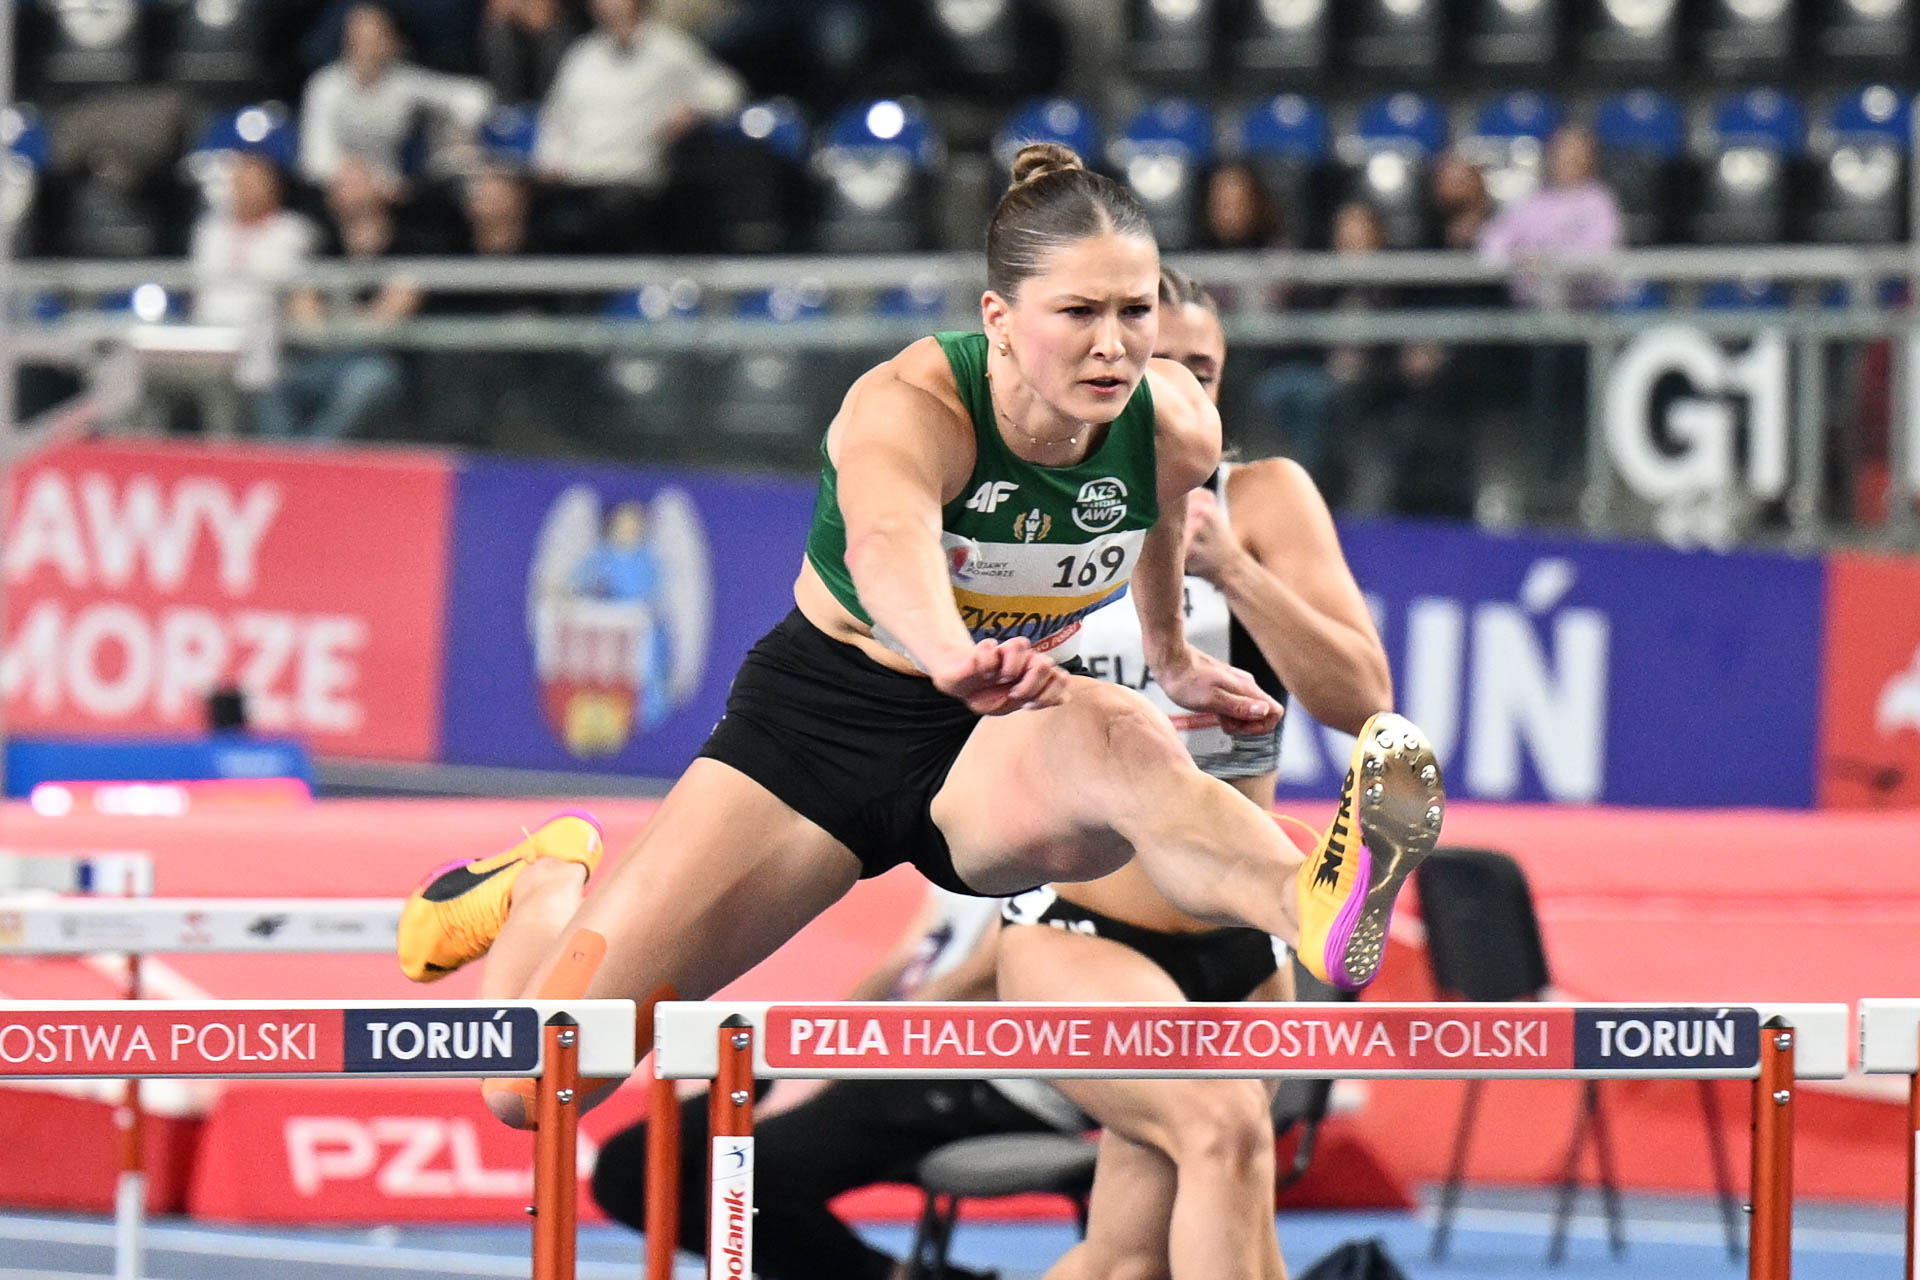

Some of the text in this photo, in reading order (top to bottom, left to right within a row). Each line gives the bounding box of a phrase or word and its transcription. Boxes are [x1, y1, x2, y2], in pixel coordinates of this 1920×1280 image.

[1604, 326, 1790, 497] G1
[1080, 507, 1120, 520] AWF
[1087, 485, 1117, 500] AZS
[2, 474, 282, 593] AWY
[1052, 545, 1125, 588] 169
[1311, 767, 1354, 894] NITRO
[0, 1010, 513, 1063] OSTWA POLSKI TORUŃ
[790, 1008, 1735, 1058] PZLA HALOWE MISTRZOSTWA POLSKI TORUŃ
